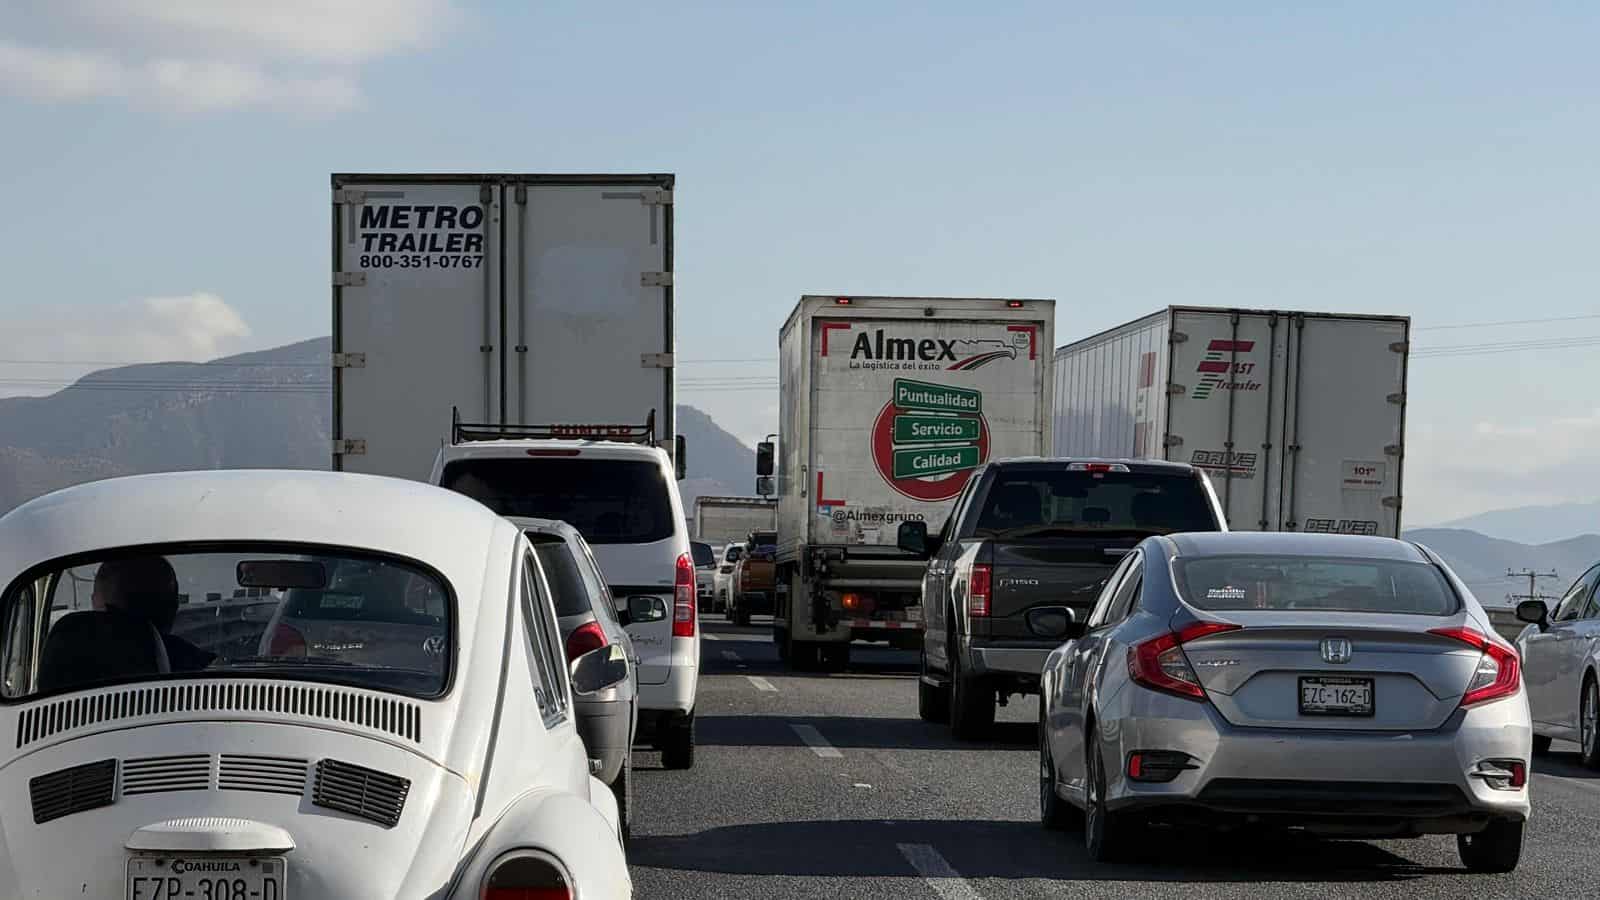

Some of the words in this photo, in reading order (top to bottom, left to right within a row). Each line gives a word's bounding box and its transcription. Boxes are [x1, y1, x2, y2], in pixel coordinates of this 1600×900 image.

[360, 205, 484, 229] METRO
[361, 233, 484, 253] TRAILER
[360, 255, 484, 268] 800-351-0767
[850, 329, 957, 361] Almex
[902, 361, 916, 370] del
[918, 361, 940, 370] éxito
[899, 387, 977, 408] Puntualidad
[911, 422, 963, 436] Servicio
[912, 452, 961, 469] Calidad
[1304, 518, 1378, 535] DELIVER
[1303, 687, 1371, 705] EZC-162-D
[170, 859, 241, 875] COAHUILA
